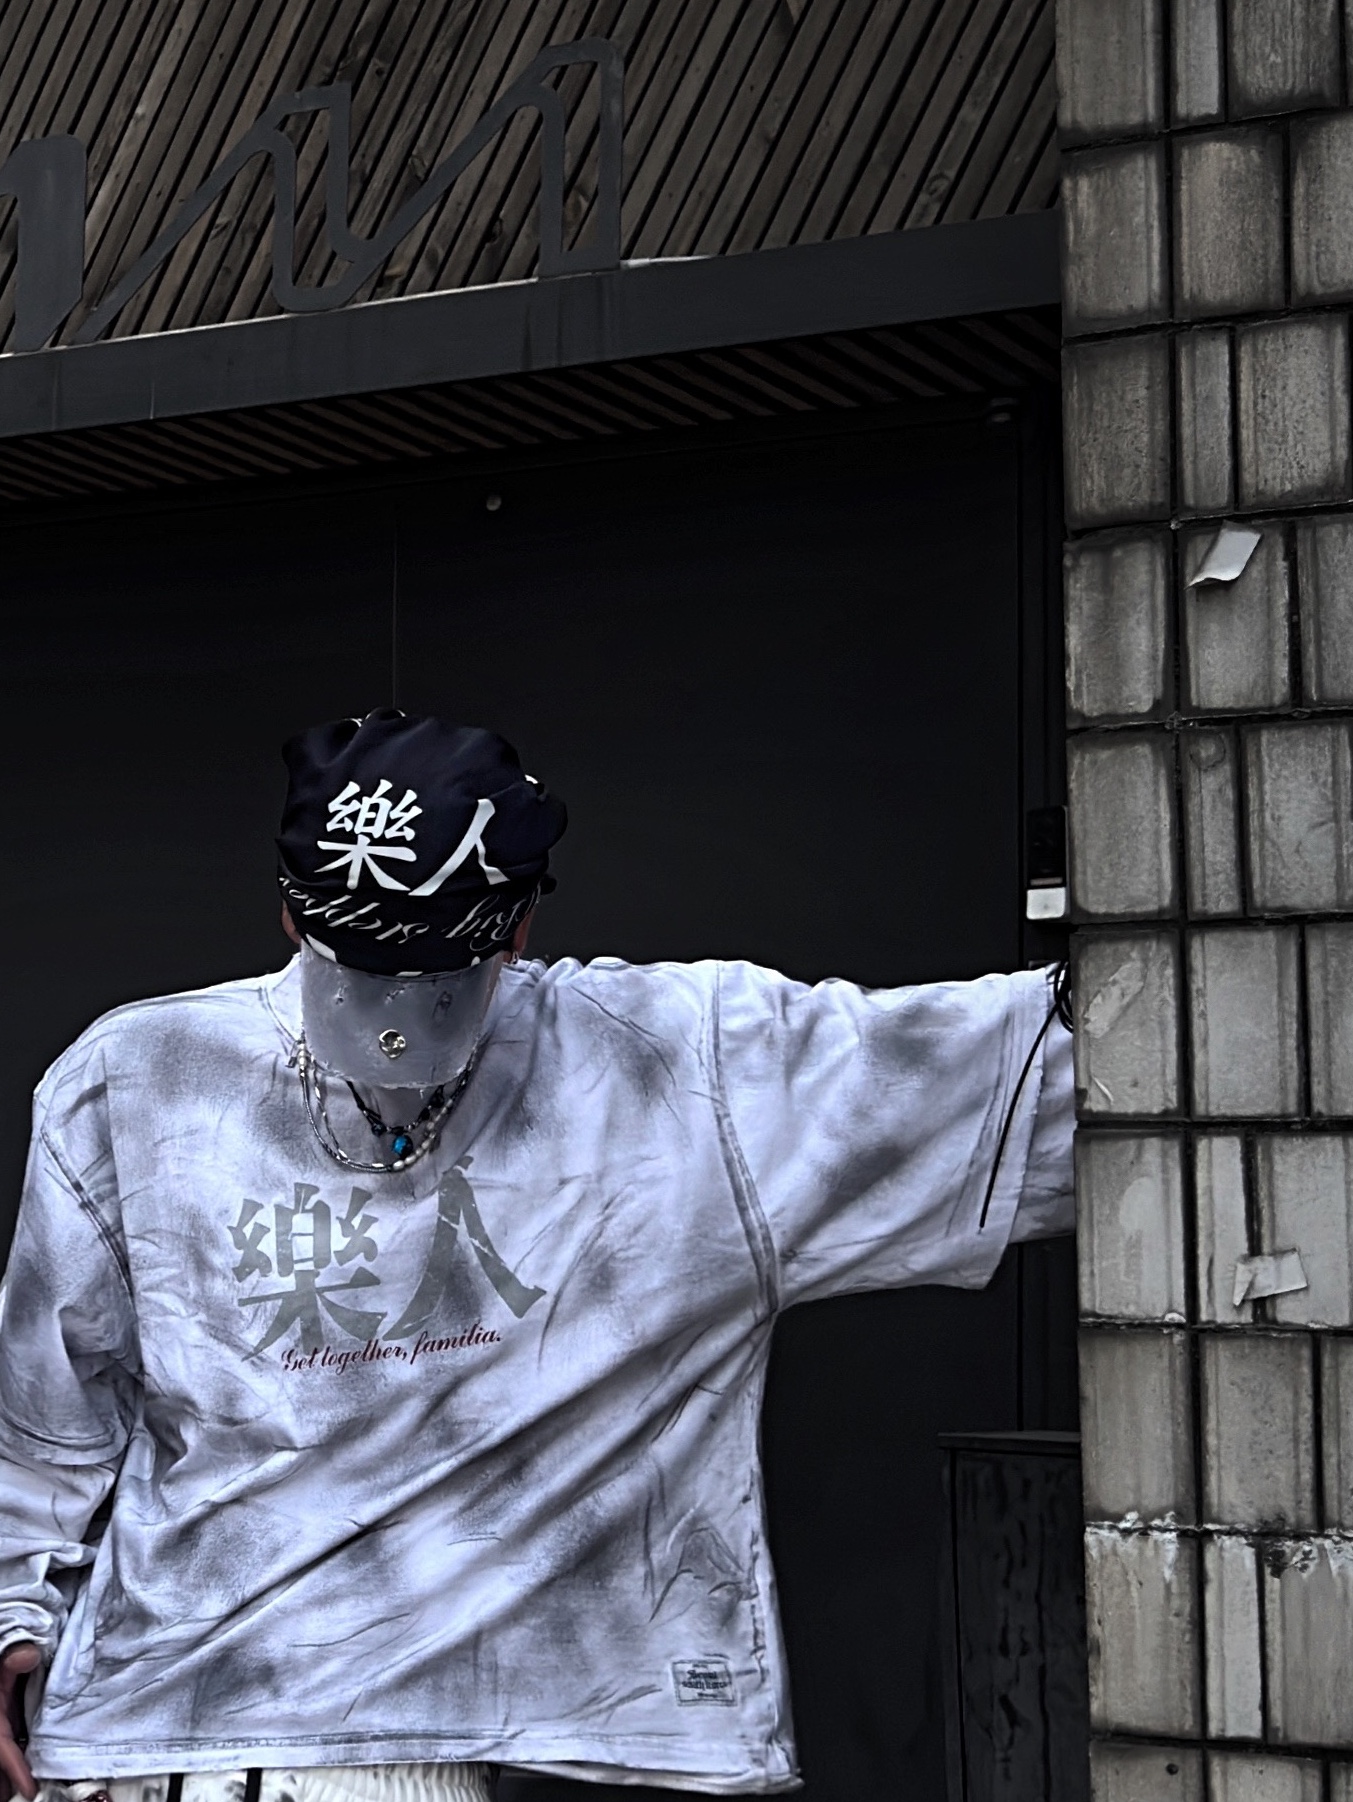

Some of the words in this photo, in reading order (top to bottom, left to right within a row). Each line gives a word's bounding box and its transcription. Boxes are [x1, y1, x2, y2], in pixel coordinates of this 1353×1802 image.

[314, 779, 510, 896] 樂人
[227, 1155, 547, 1362] 樂人
[280, 1346, 322, 1372] Get
[321, 1339, 408, 1375] together,
[409, 1321, 501, 1365] familia.
